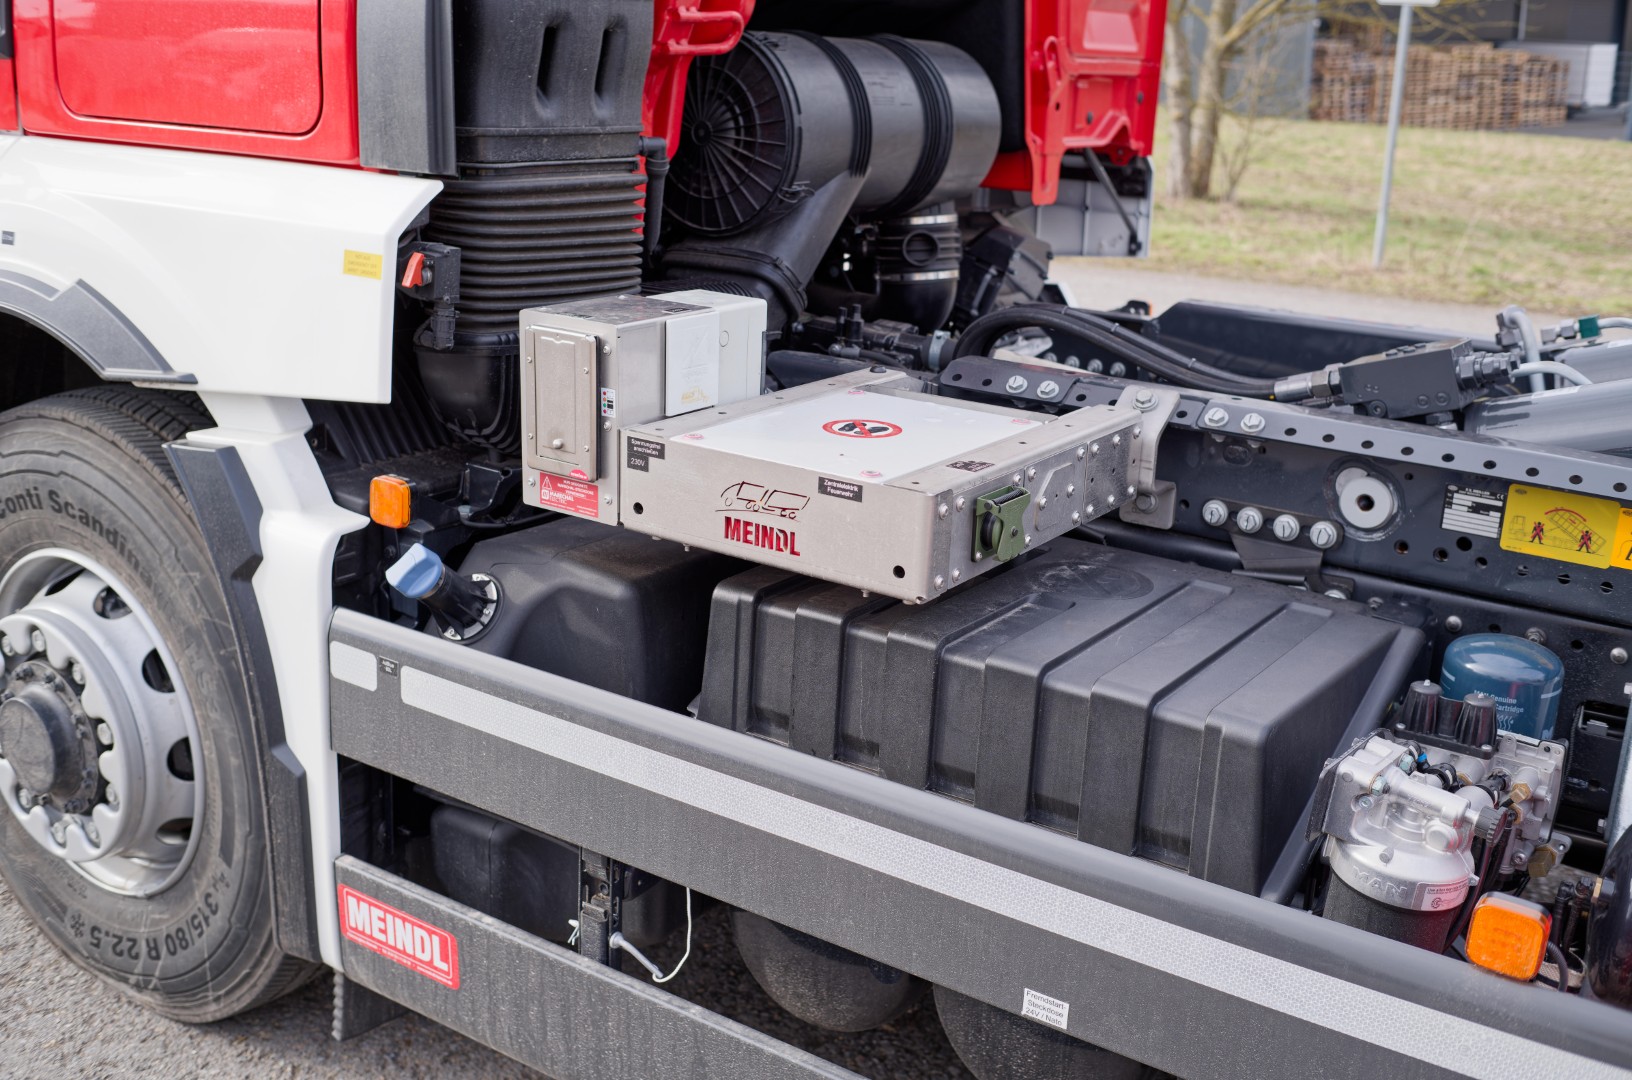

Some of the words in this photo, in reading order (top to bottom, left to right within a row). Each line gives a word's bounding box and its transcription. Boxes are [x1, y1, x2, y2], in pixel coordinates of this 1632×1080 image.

[630, 457, 646, 467] 230V
[824, 479, 859, 492] Zentralelektrik
[827, 486, 854, 498] Feuerwehr
[724, 516, 800, 557] MEINDL
[165, 892, 218, 957] 315/80
[346, 895, 449, 972] MEINDL
[89, 924, 141, 961] 22.5
[145, 938, 162, 961] R
[1025, 1007, 1040, 1017] 24V
[1045, 1014, 1063, 1026] Nato
[1027, 999, 1064, 1019] Steckdose
